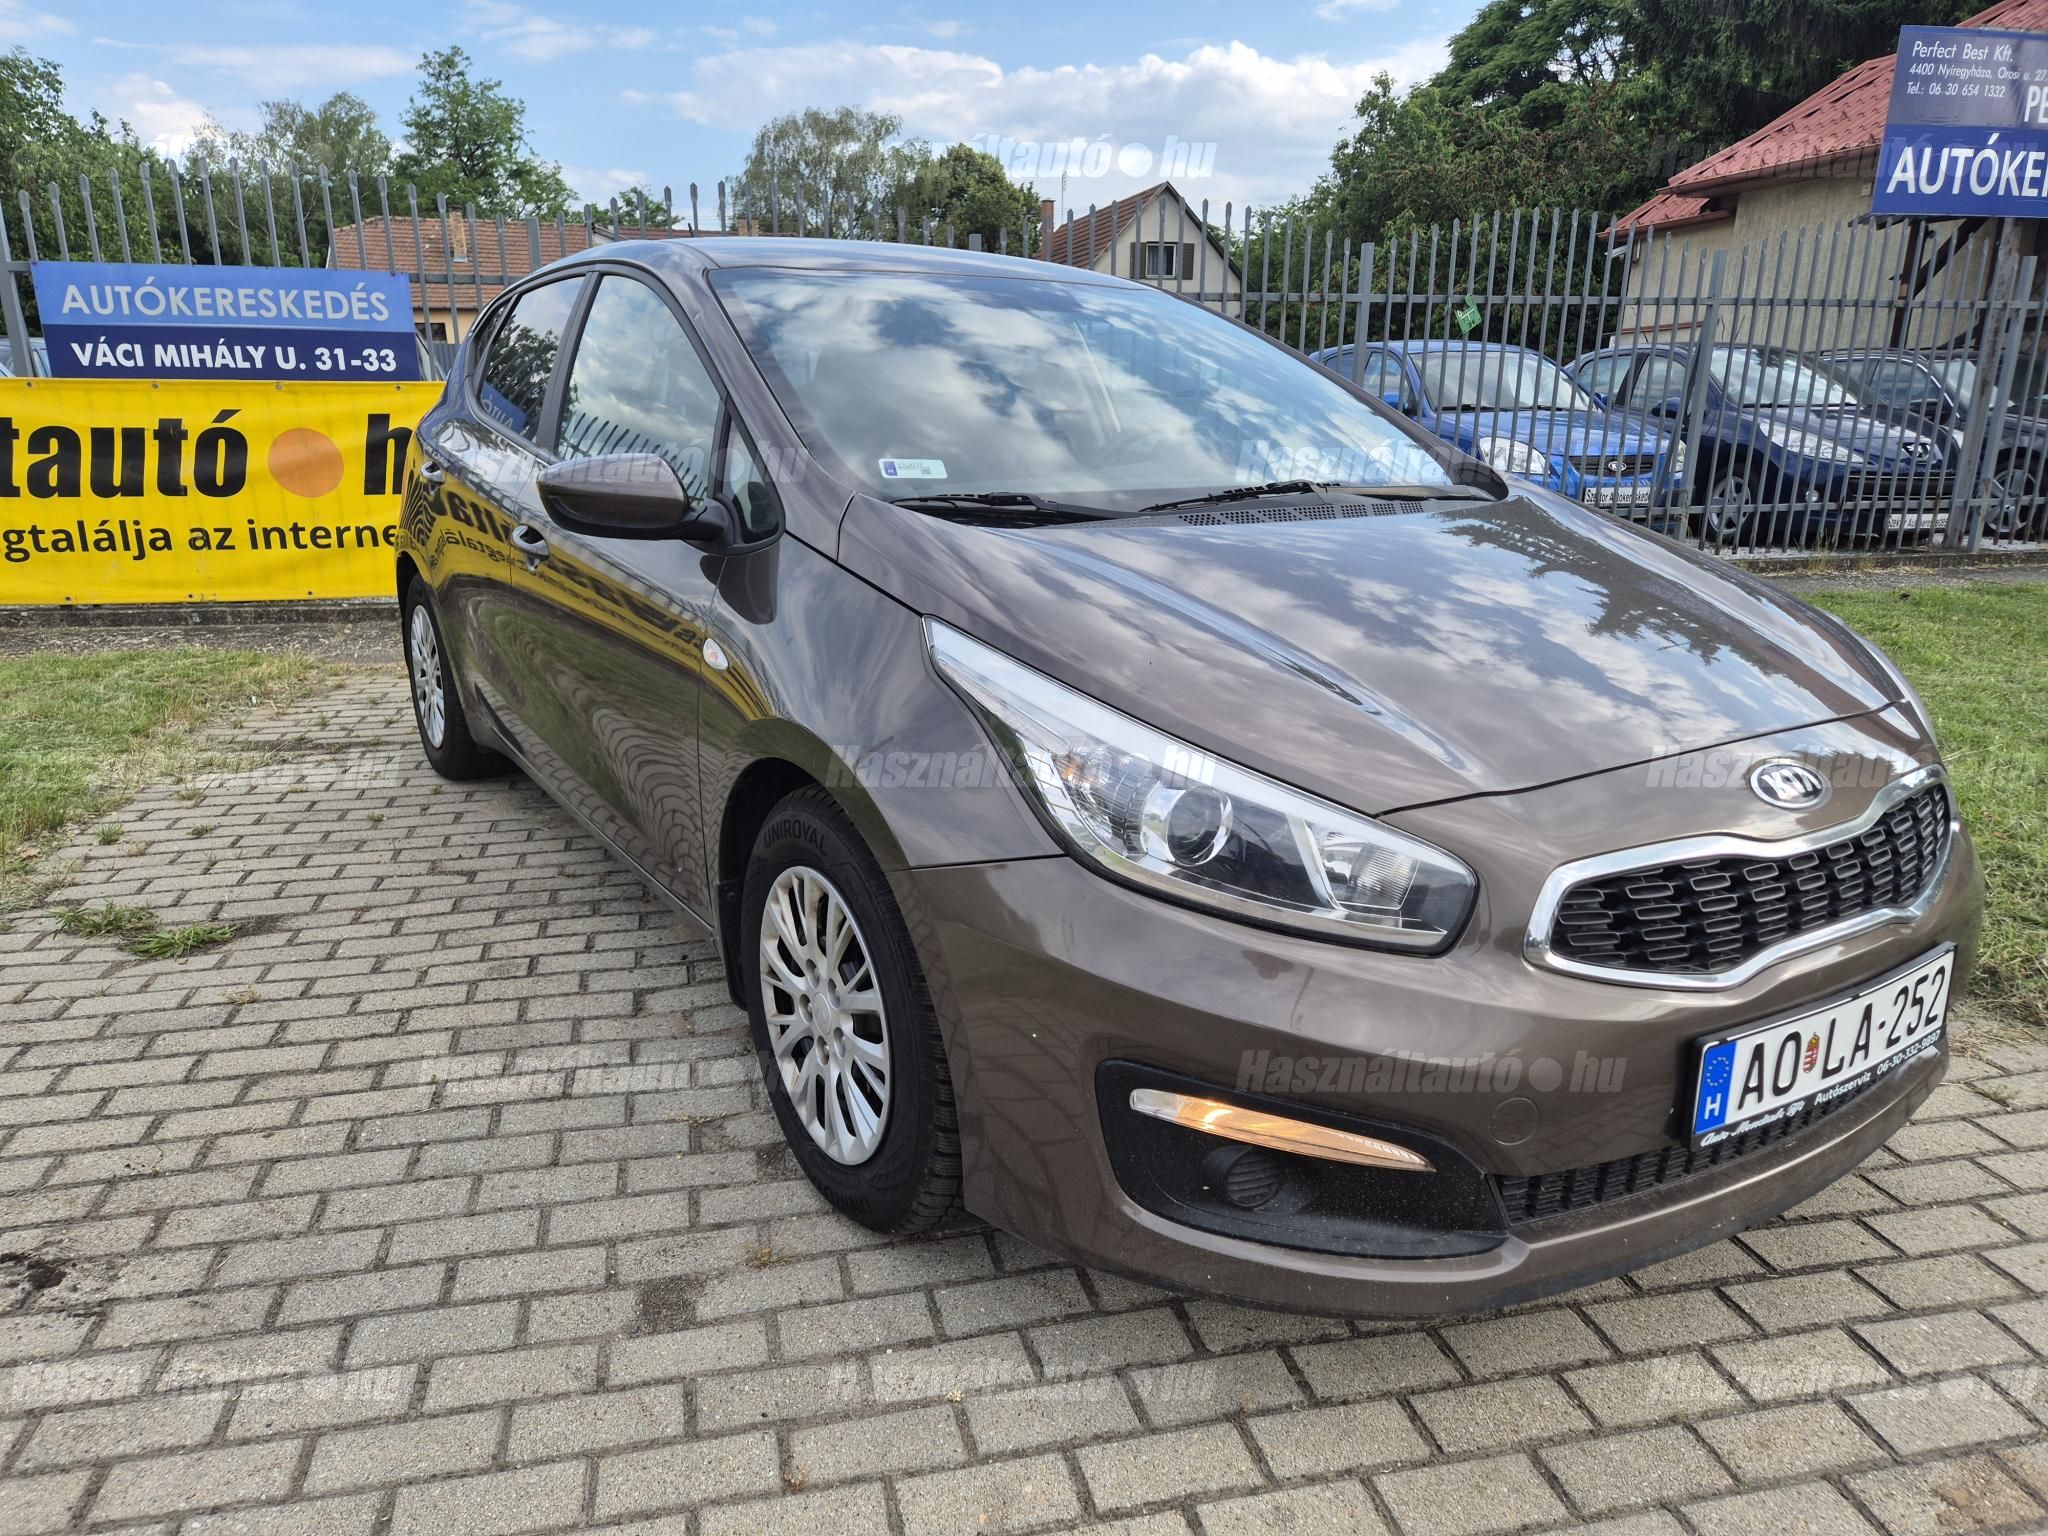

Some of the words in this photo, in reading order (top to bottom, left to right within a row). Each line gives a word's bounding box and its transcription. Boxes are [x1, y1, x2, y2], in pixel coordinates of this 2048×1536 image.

[1911, 40, 1957, 58] Perfect
[1962, 43, 1990, 60] Best
[1993, 44, 2014, 62] Kft.
[1909, 63, 1934, 76] 4400
[1937, 63, 1993, 80] Nyíregyháza,
[1998, 66, 2021, 80] Orosi
[1928, 82, 1941, 96] 06
[1945, 83, 1958, 96] 30
[1961, 84, 1979, 97] 654
[1983, 85, 2006, 98] 1332
[1885, 132, 2048, 197] AUTÓKE
[61, 276, 390, 322] AUTÓKERESKEDÉS
[70, 335, 145, 368] VÁCI
[154, 338, 266, 370] MIHÁLY
[274, 346, 306, 371] U.
[314, 346, 397, 373] 31-33
[2, 519, 172, 562] gtalálja
[187, 526, 236, 551] az
[763, 818, 828, 857] UNIROYAL
[1737, 1030, 1801, 1110] AO
[1821, 965, 1946, 1080] LA-252
[1703, 1093, 1722, 1120] H
[1814, 1071, 1872, 1106] Autószerviz
